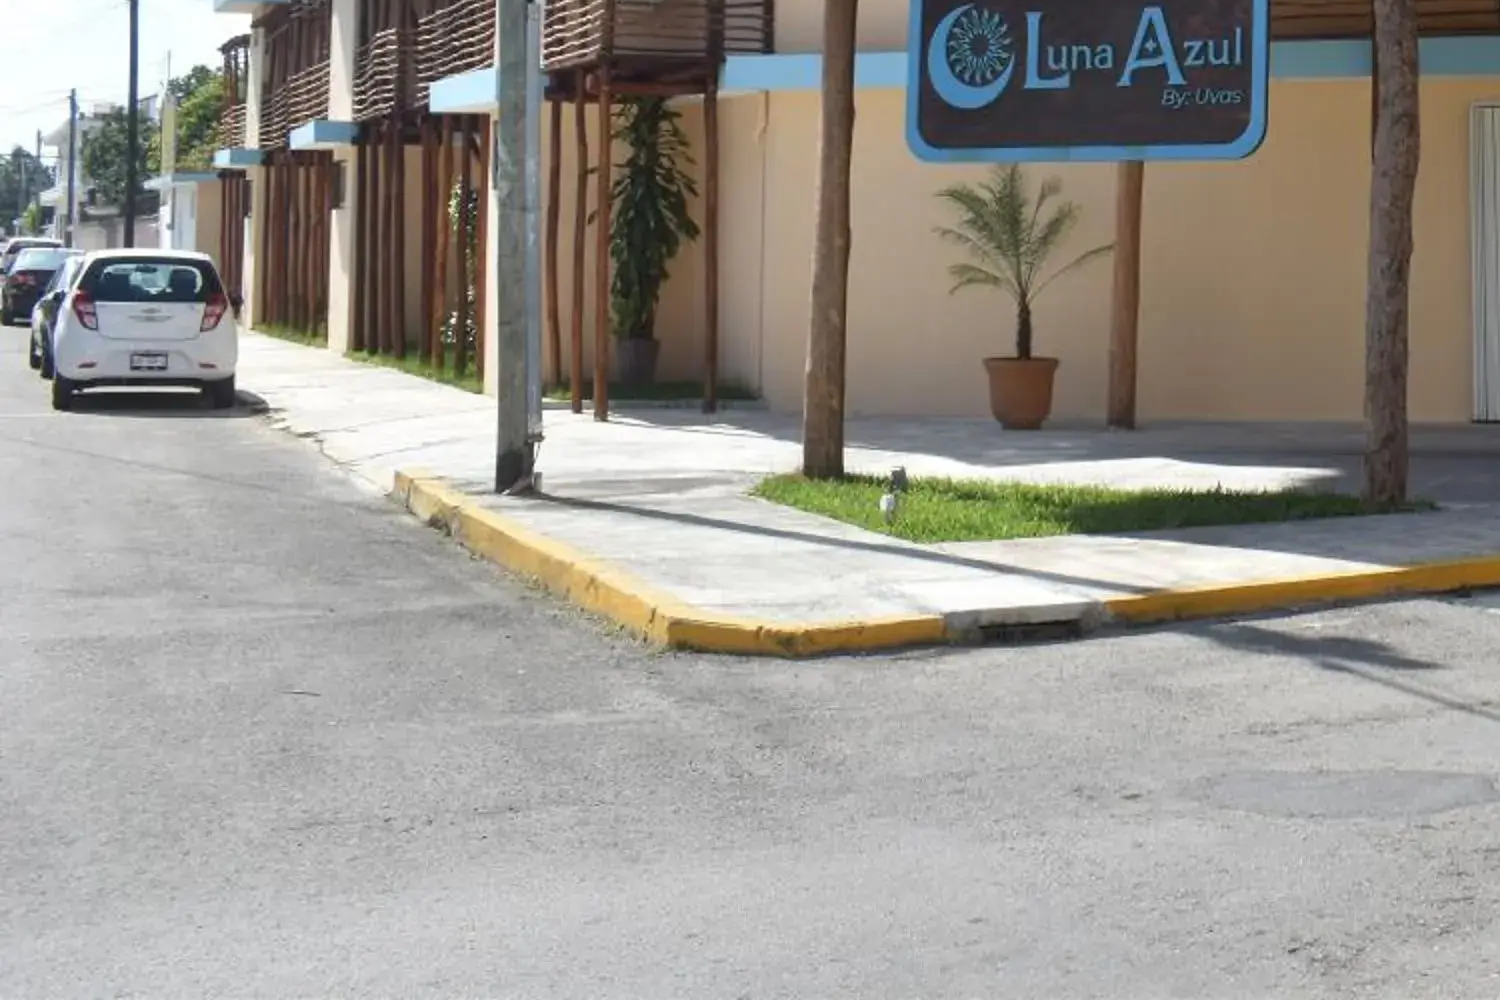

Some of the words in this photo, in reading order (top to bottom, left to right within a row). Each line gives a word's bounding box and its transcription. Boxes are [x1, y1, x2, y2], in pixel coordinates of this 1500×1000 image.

[1023, 11, 1114, 89] Luna
[1116, 6, 1243, 87] Azul
[1161, 88, 1191, 109] By:
[1195, 87, 1244, 105] Uvas
